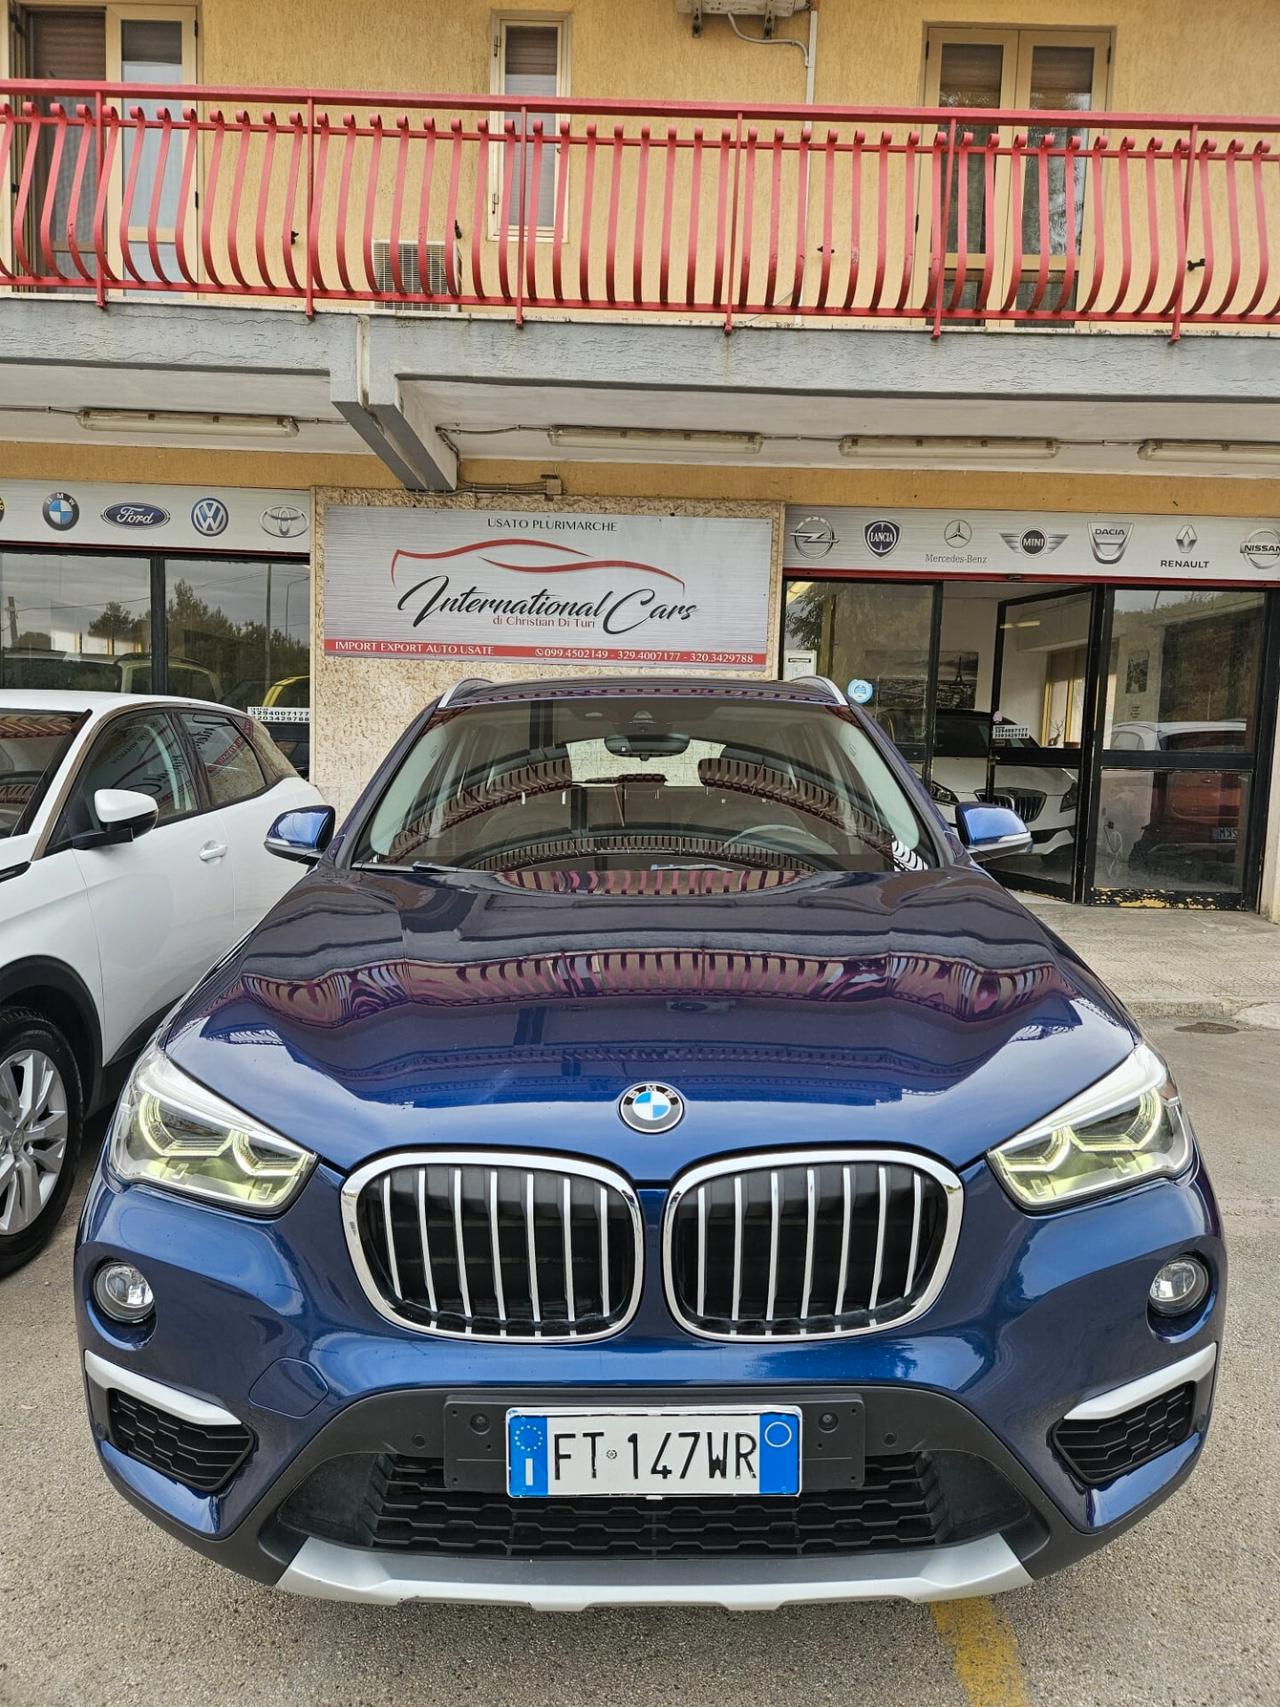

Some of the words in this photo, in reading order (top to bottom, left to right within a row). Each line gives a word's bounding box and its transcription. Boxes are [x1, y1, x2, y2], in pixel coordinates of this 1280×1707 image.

[117, 506, 154, 524] Ford
[487, 518, 529, 529] USATO
[532, 519, 618, 532] PLURIMARCHE
[870, 531, 894, 543] LANCIA
[1095, 528, 1126, 536] DACIA
[1023, 538, 1044, 547] MINI
[924, 553, 988, 564] Mercedes-Benz
[1160, 559, 1210, 569] RENAULT
[397, 575, 614, 628] International
[602, 588, 698, 635] Cars
[492, 615, 503, 625] di
[506, 616, 555, 627] Christian
[558, 617, 570, 627] Di
[573, 618, 595, 628] Turi
[335, 641, 378, 651] IMPORT
[380, 642, 423, 653] EXPORT
[424, 644, 458, 654] AUTO
[459, 645, 495, 655] USATE
[544, 648, 609, 659] 099.4502149
[617, 650, 681, 661] 329.4007177
[689, 653, 754, 663] 320.3429788
[554, 1432, 605, 1480] FT
[627, 1431, 758, 1480] 147WR
